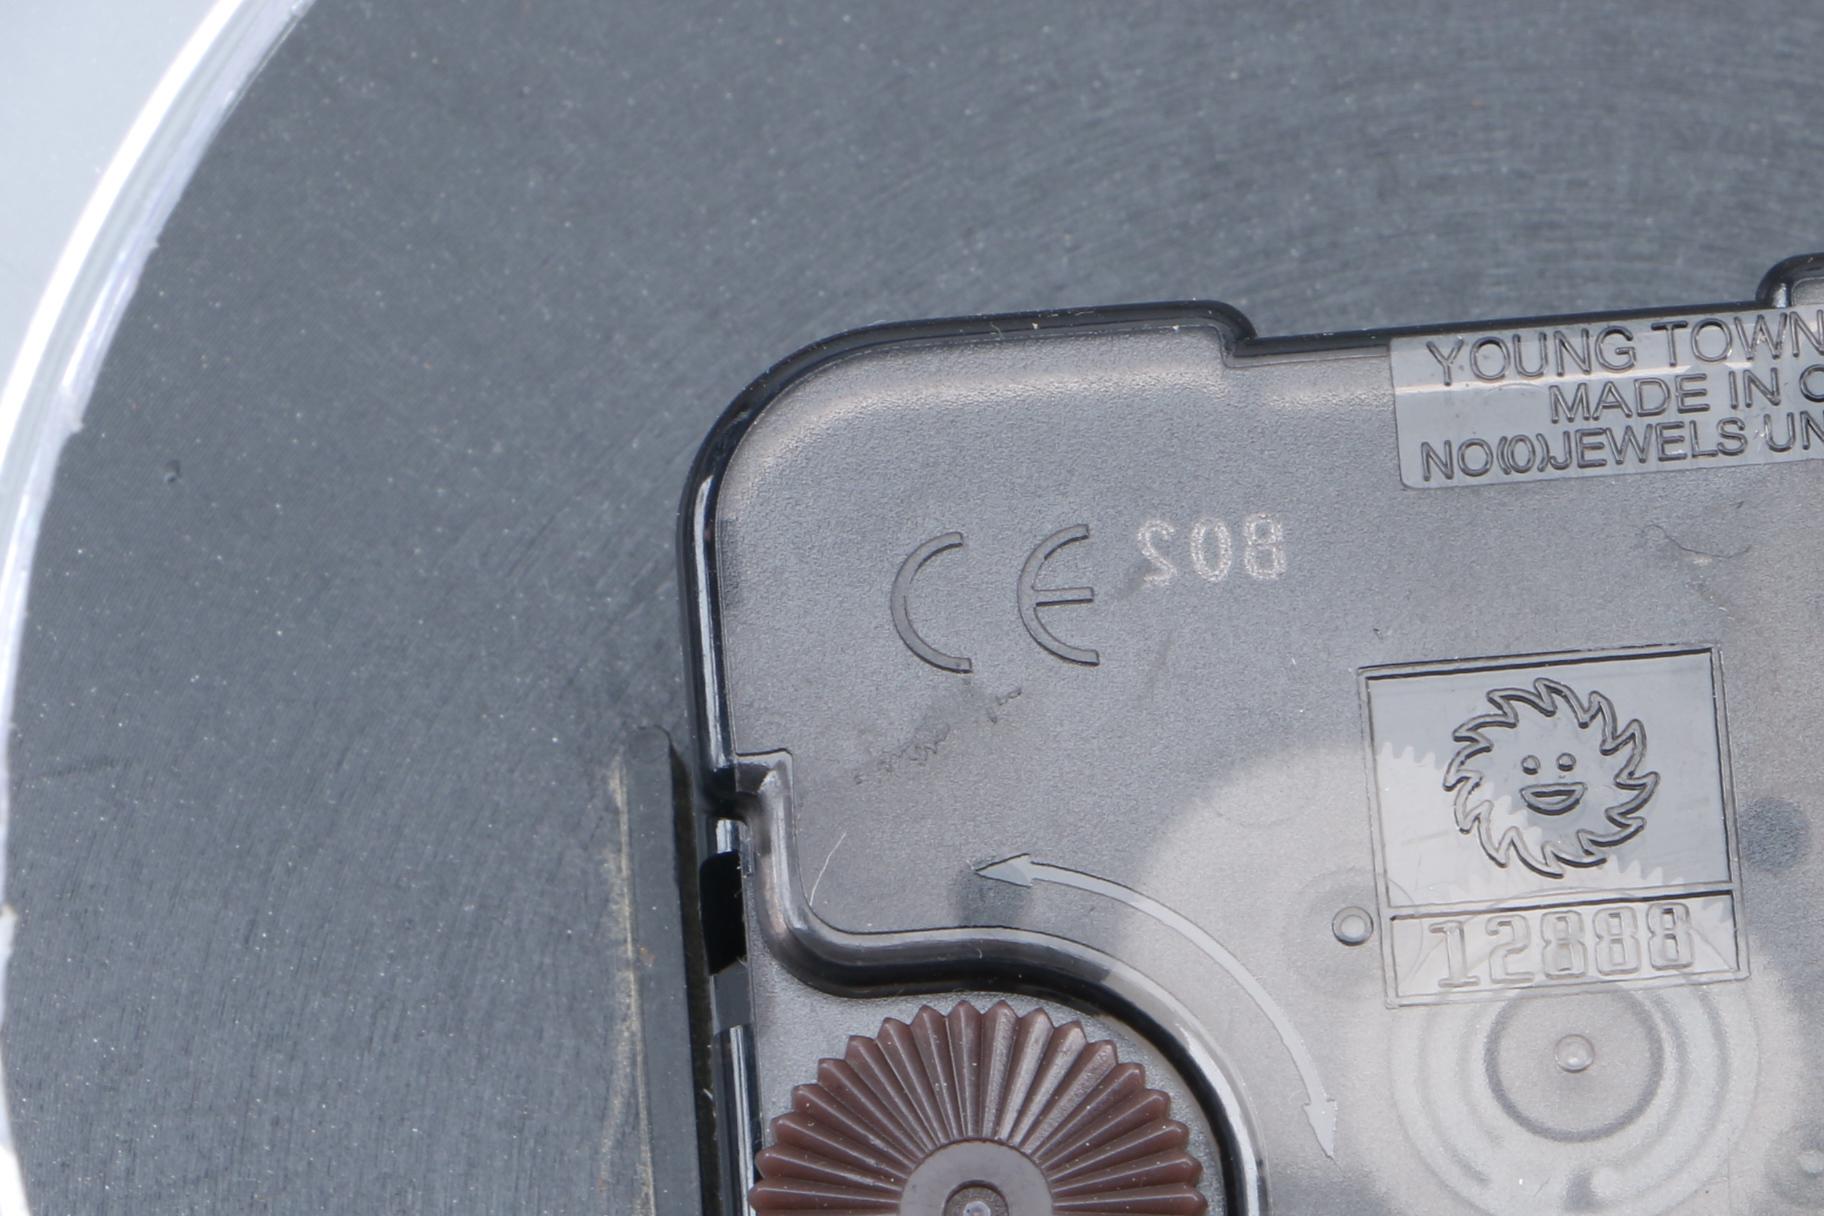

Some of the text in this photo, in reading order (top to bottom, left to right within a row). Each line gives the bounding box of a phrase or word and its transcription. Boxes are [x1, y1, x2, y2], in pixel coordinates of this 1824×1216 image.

[1425, 325, 1637, 387] YOUNG
[1549, 372, 1711, 424] MADE
[1728, 366, 1782, 410] IN
[1429, 902, 1695, 990] 12888
